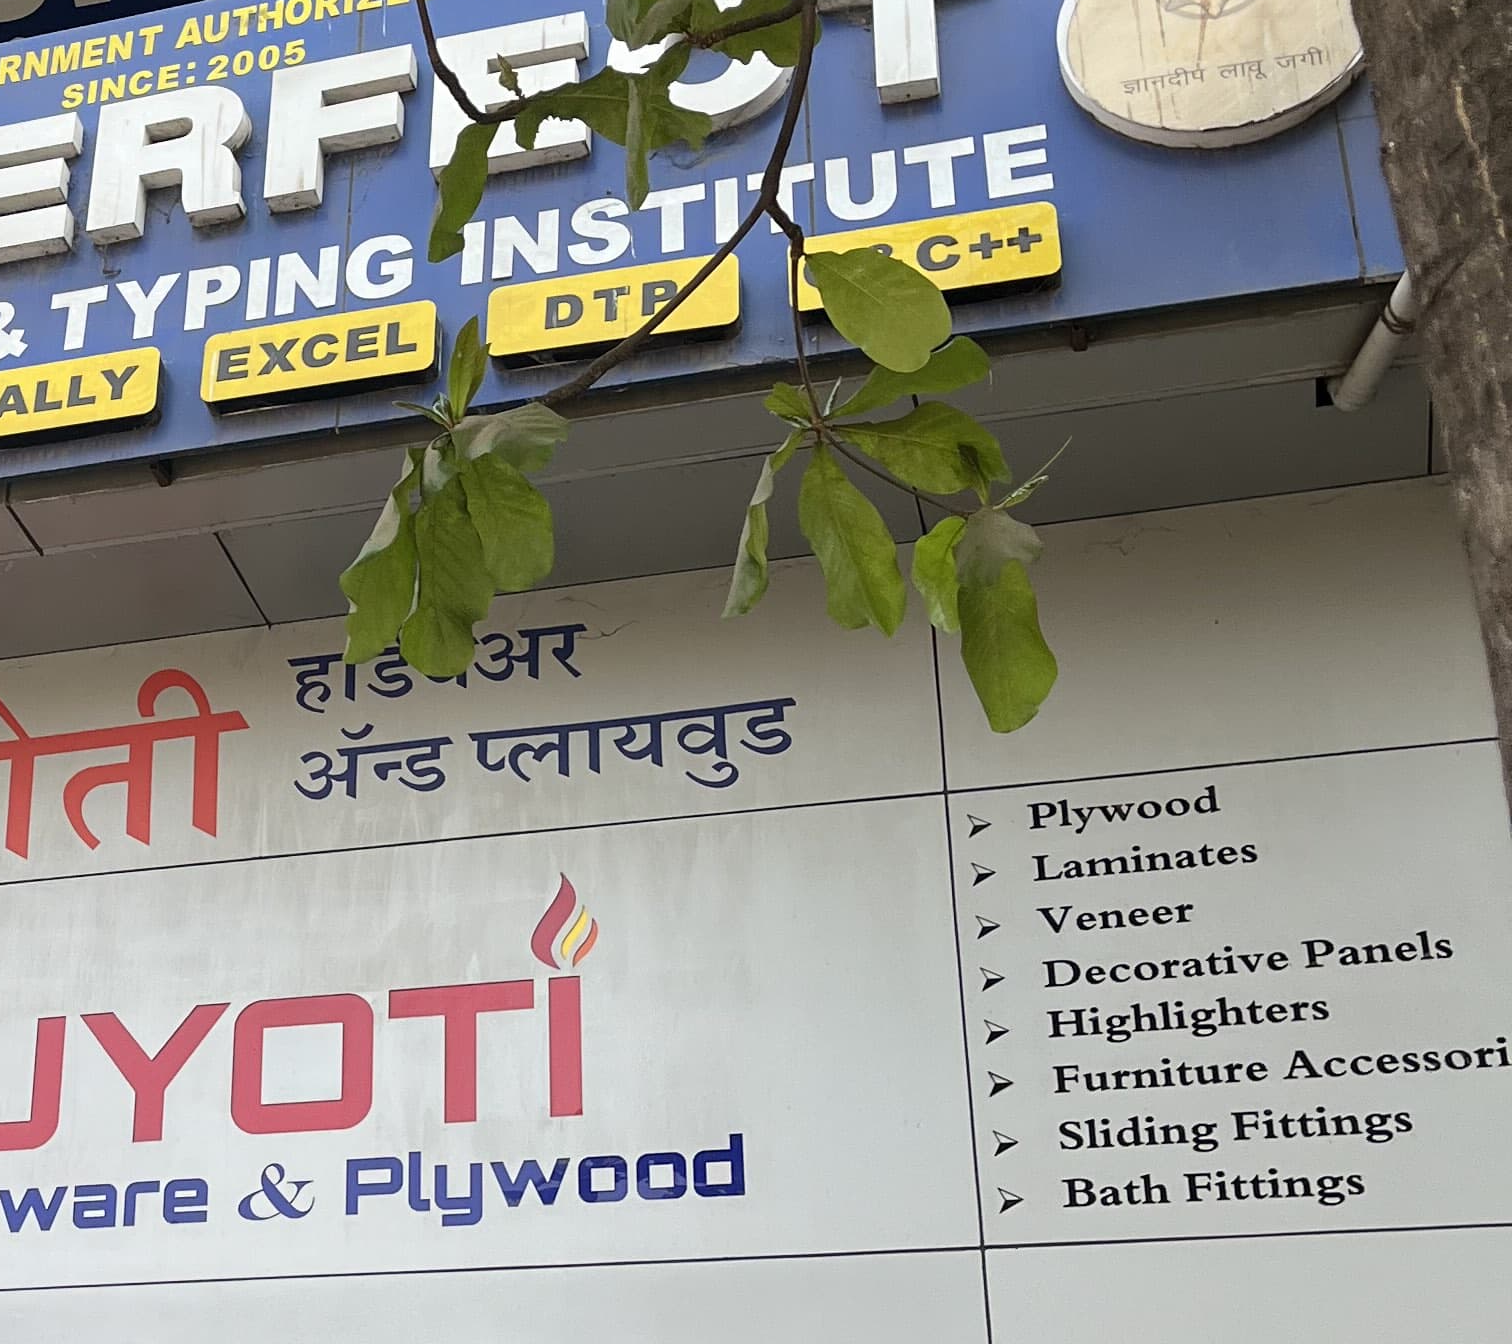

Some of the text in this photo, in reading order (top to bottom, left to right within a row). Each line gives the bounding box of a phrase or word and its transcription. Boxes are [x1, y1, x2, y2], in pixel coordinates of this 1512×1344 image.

[61, 38, 308, 112] SINCE: 2005
[49, 233, 416, 352] TYPING
[458, 123, 1055, 287] INSTITUTE
[215, 321, 420, 384] EXCEL
[544, 279, 680, 331] DTP
[472, 697, 797, 792] प्लायवुड
[1027, 784, 1221, 834] Plywood
[1032, 838, 1260, 884] Laminates
[1037, 897, 1195, 935] Veneer
[1042, 929, 1455, 991] Decorative Panels
[1047, 994, 1331, 1046] Highlighters
[1052, 1036, 1512, 1096] Furniture Accessori
[1058, 1104, 1414, 1155] Sliding Fittings
[237, 1162, 315, 1224] &
[343, 1132, 748, 1228] Plywood
[1062, 1167, 1366, 1210] Bath Fittings
